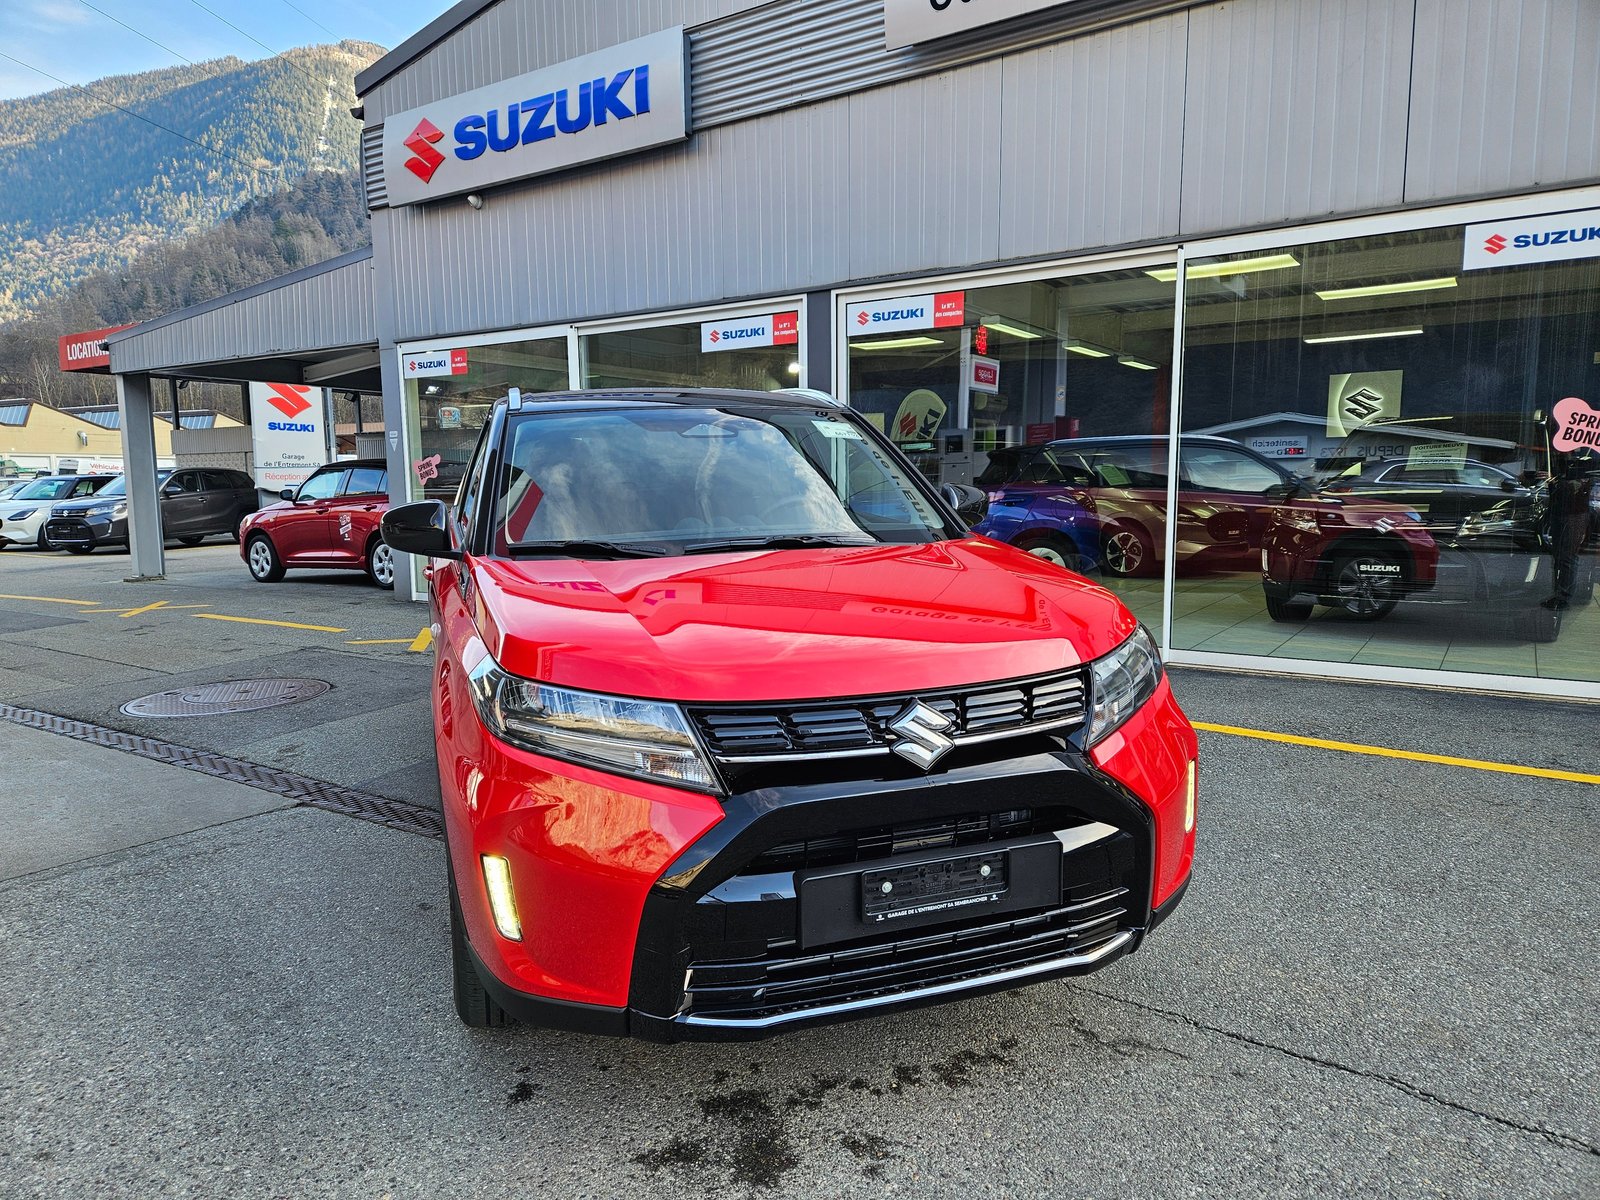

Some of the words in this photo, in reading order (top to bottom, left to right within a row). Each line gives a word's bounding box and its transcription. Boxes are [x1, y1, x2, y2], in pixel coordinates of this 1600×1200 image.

[454, 64, 650, 161] SUZUKI
[872, 308, 925, 322] SUZUKI
[722, 327, 765, 340] SUZUKI
[417, 360, 446, 369] SUZUKI
[268, 421, 315, 432] SUZUKI
[282, 452, 305, 461] Garage
[1360, 564, 1400, 572] SUZUKI
[887, 910, 908, 918] GARAGE
